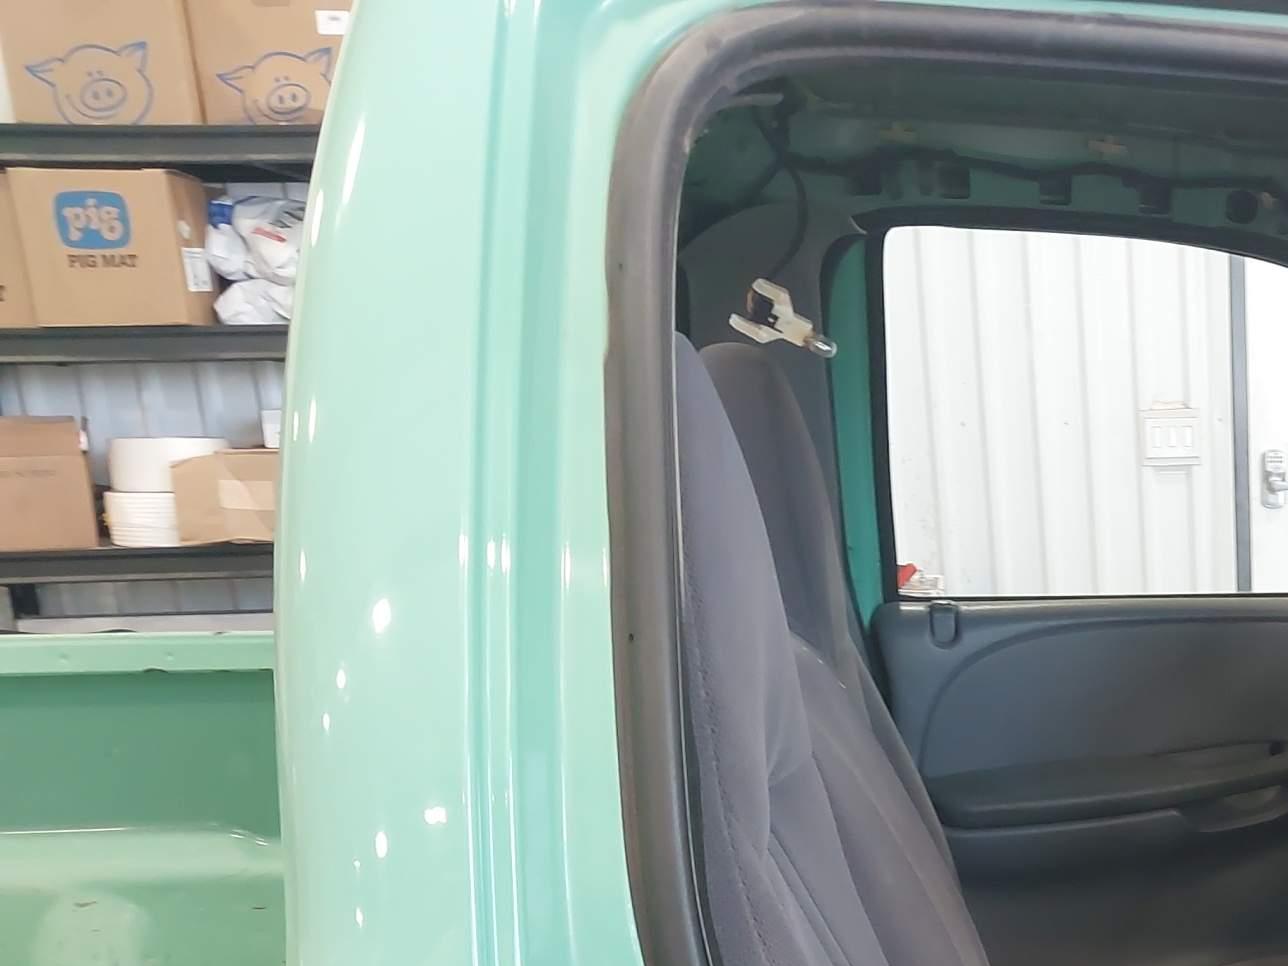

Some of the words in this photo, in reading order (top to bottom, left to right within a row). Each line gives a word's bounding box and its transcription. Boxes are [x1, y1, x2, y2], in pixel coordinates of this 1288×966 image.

[62, 198, 125, 241] pig
[66, 254, 98, 268] PIG
[101, 254, 139, 268] MAT
